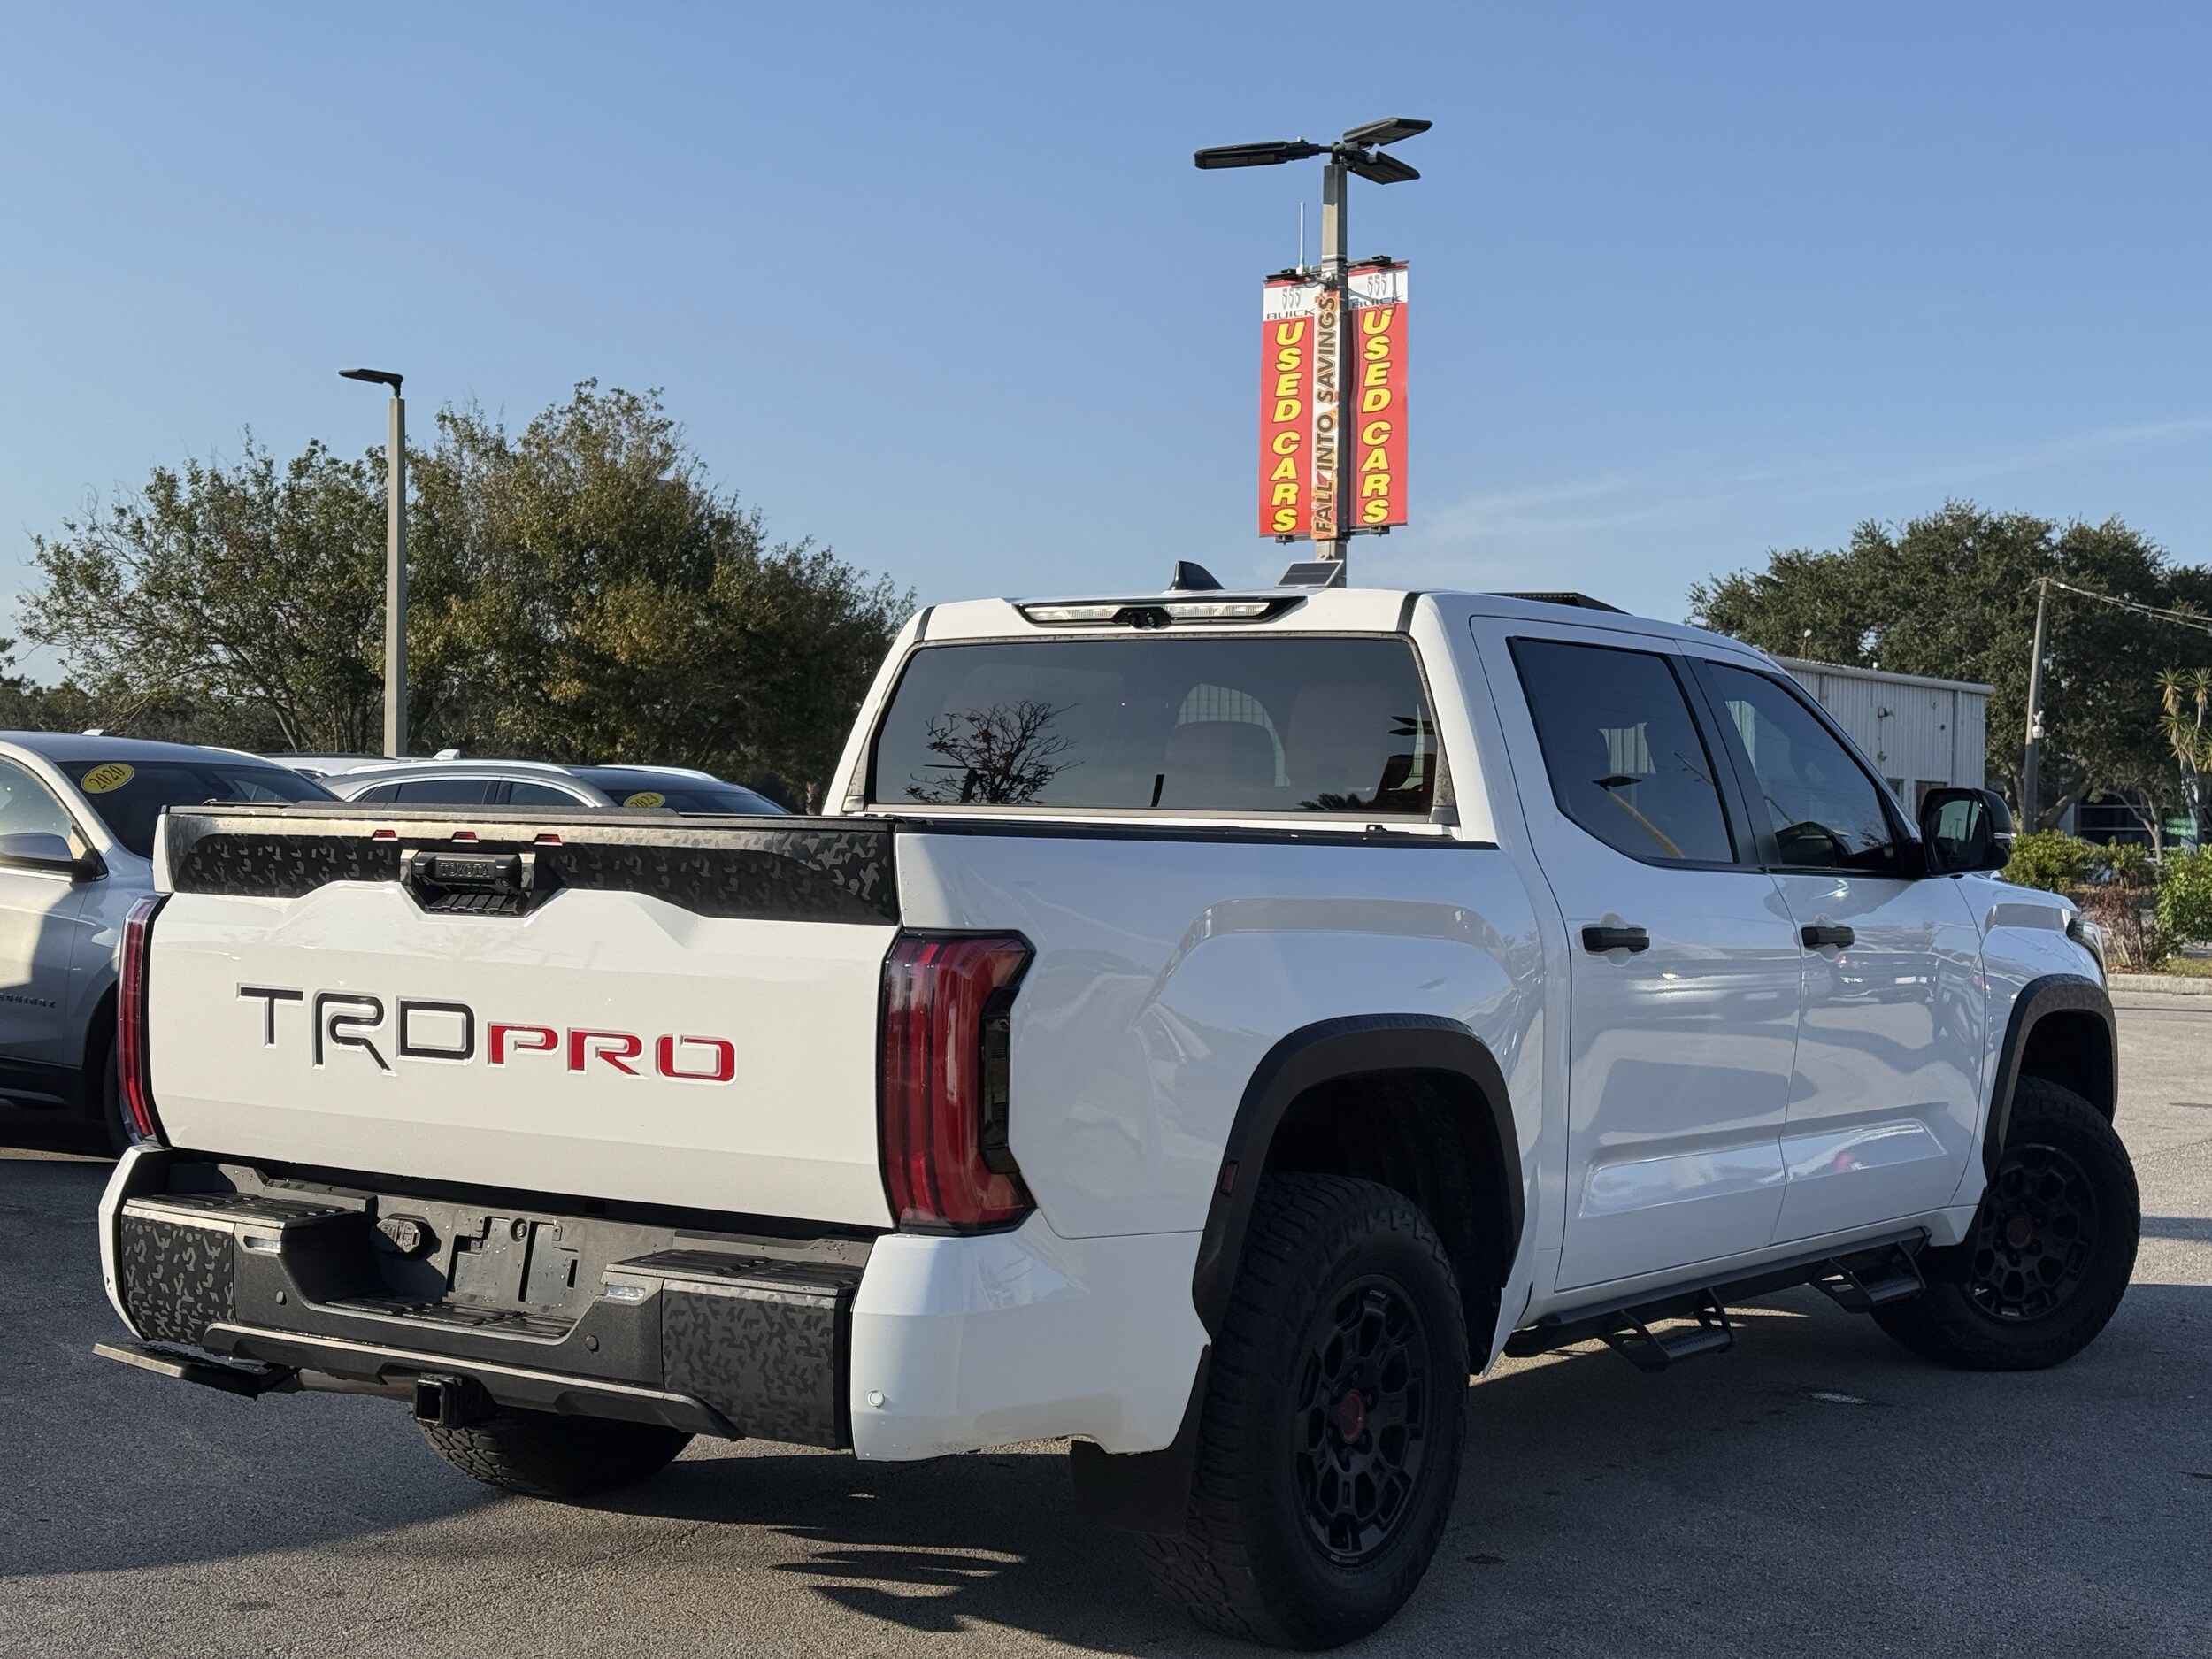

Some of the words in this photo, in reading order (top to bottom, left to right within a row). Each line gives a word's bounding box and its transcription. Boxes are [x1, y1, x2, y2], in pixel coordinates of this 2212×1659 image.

[1267, 308, 1315, 320] BUICK
[1352, 295, 1403, 308] BUICK
[1272, 320, 1306, 423] USED
[1317, 297, 1336, 403] SAVINGS
[1361, 308, 1394, 414] USED
[1269, 430, 1302, 533] CARS
[1316, 413, 1334, 473] INTO
[1359, 419, 1393, 525] CARS
[1316, 481, 1333, 533] FALL
[88, 764, 126, 790] 2020
[440, 862, 490, 879] TOYOTA
[237, 982, 476, 1075] TRD
[488, 1021, 736, 1085] PRO
